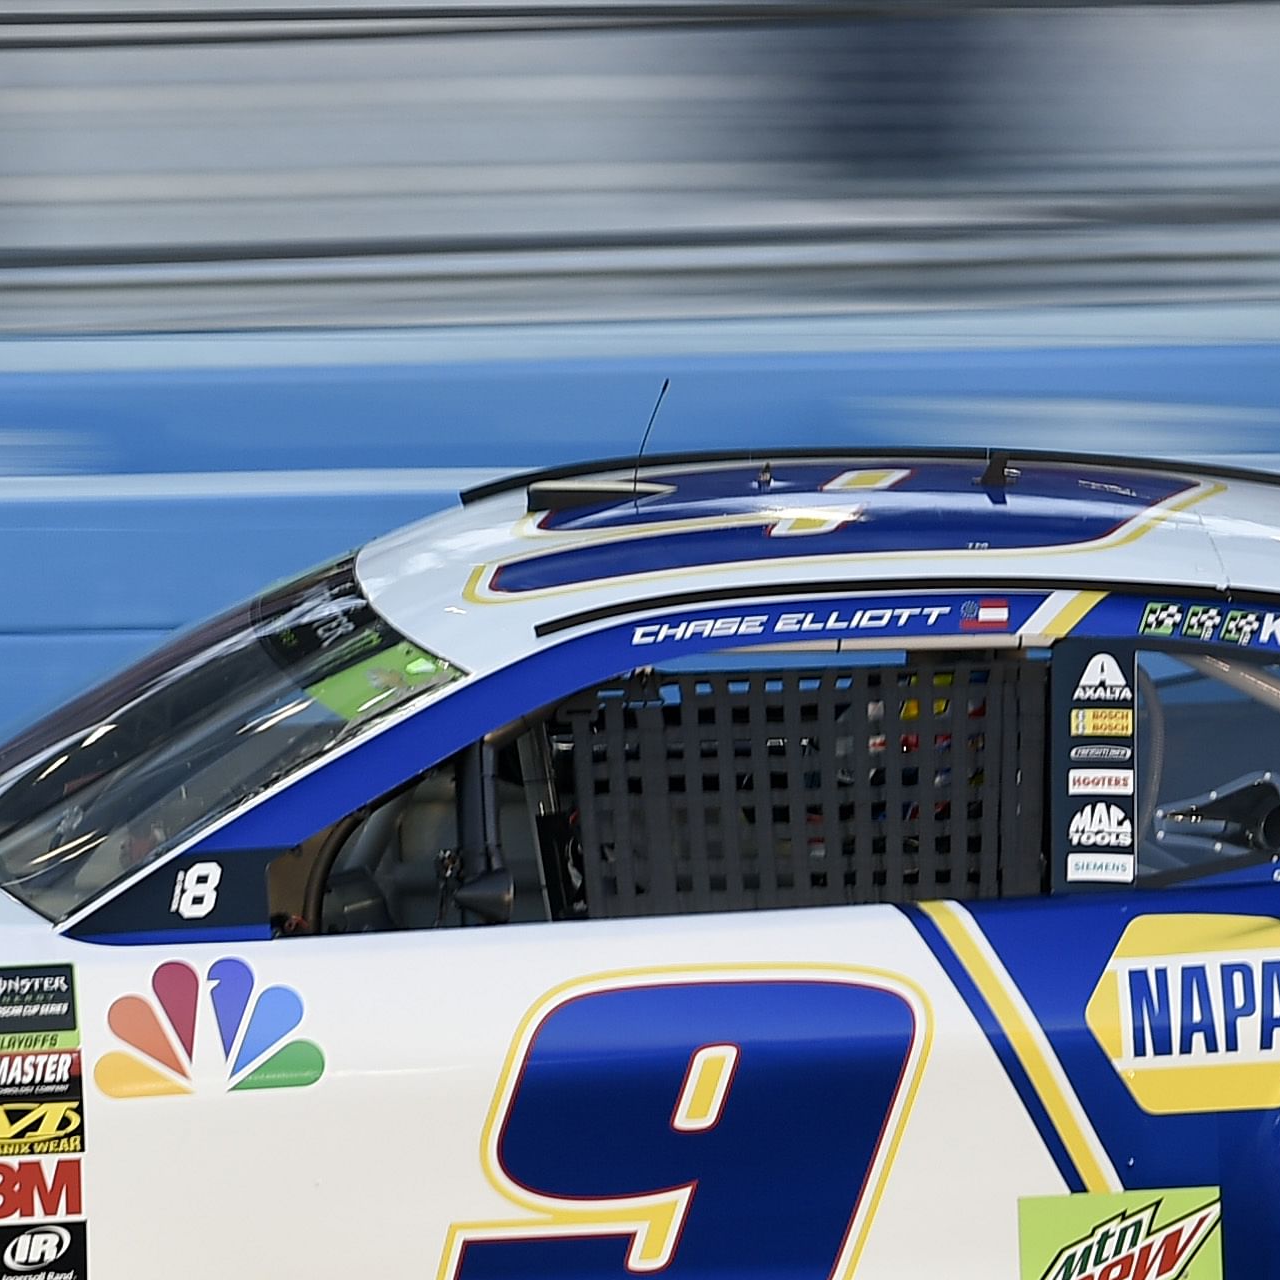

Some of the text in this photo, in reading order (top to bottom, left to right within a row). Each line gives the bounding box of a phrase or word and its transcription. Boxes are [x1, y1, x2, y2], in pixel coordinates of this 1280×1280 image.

[631, 606, 951, 646] CHASE ELLIOTT
[1073, 686, 1132, 700] AXALTA
[1092, 711, 1129, 721] BOSCH
[1092, 722, 1129, 733] BOSCH
[1072, 776, 1129, 788] HOOTERS
[1070, 802, 1131, 832] MAC
[1069, 832, 1132, 846] TOOLS
[1074, 861, 1128, 872] SIEMENS
[33, 1135, 82, 1153] WEAR
